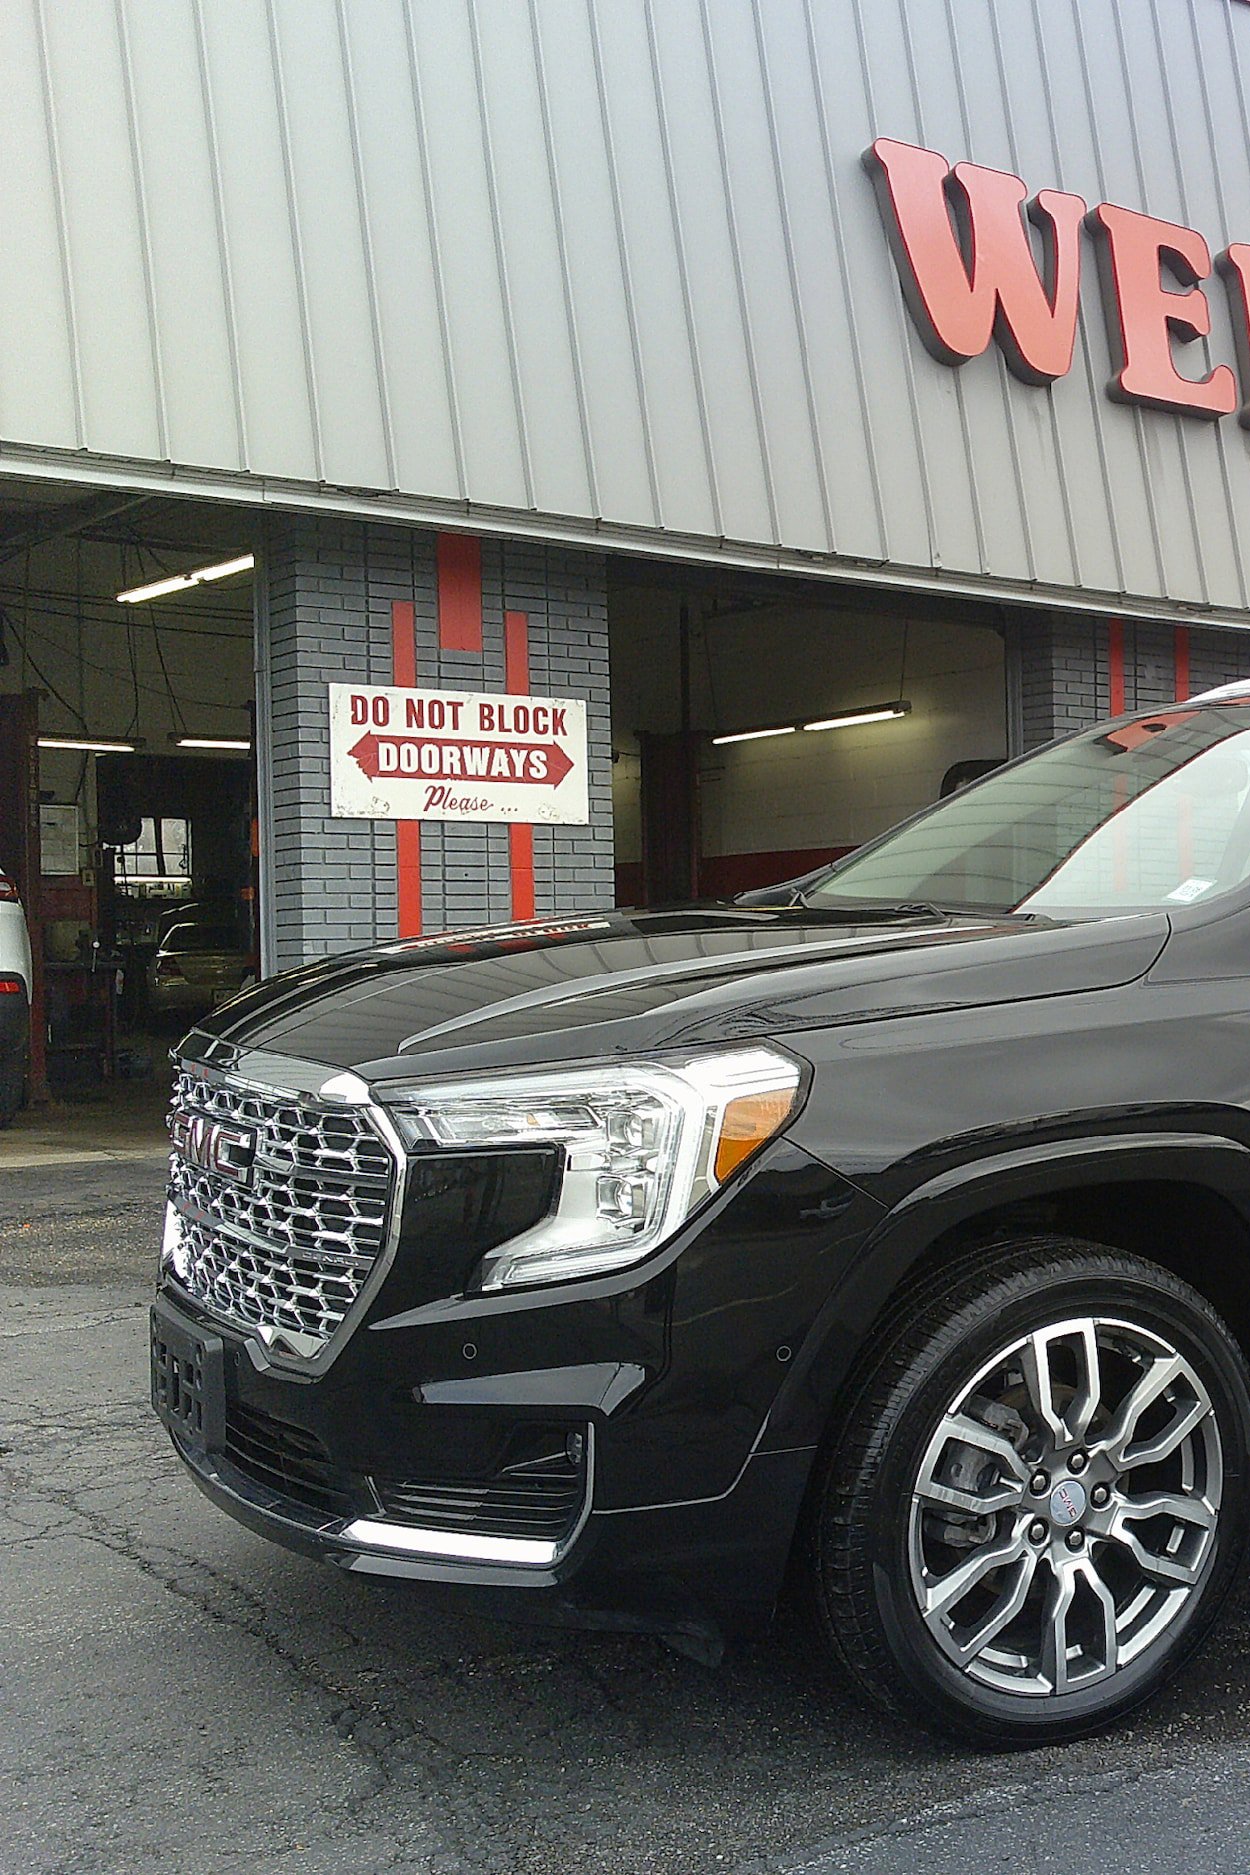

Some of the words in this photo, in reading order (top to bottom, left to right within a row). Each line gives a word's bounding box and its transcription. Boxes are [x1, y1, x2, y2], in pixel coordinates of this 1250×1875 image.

[350, 694, 390, 726] DO
[405, 698, 464, 731] NOT
[479, 703, 568, 737] BLOCK
[378, 741, 549, 780] DOORWAYS
[171, 1111, 252, 1184] GMC
